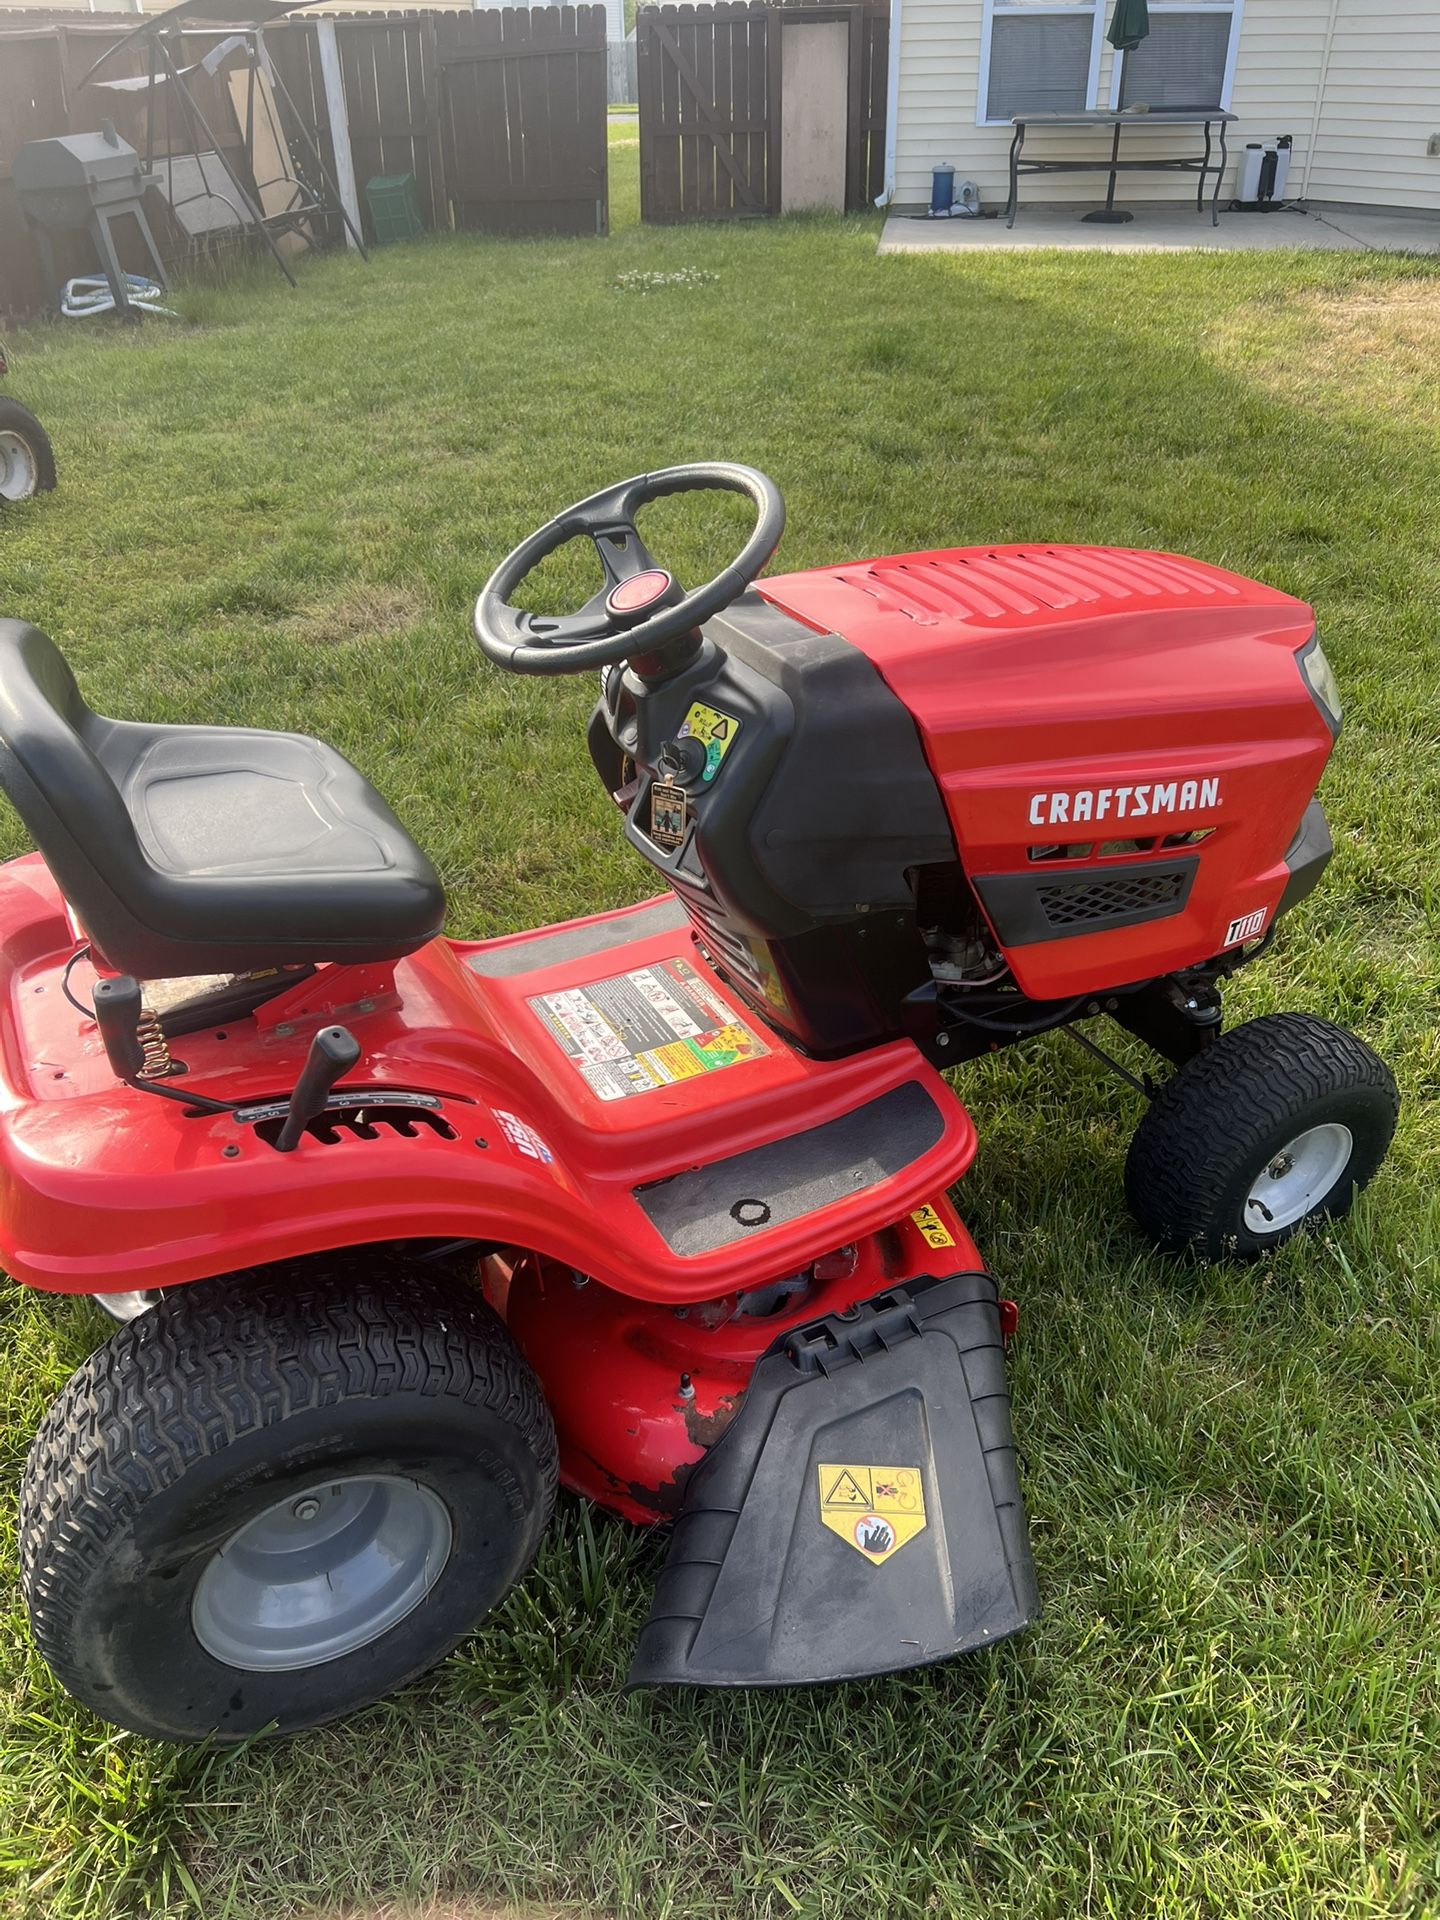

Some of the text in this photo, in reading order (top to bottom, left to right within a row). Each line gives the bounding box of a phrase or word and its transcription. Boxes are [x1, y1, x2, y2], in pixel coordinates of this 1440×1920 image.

[1029, 778, 1219, 825] CRAFTSMAN
[1228, 910, 1264, 942] T110
[496, 1109, 539, 1160] USA
